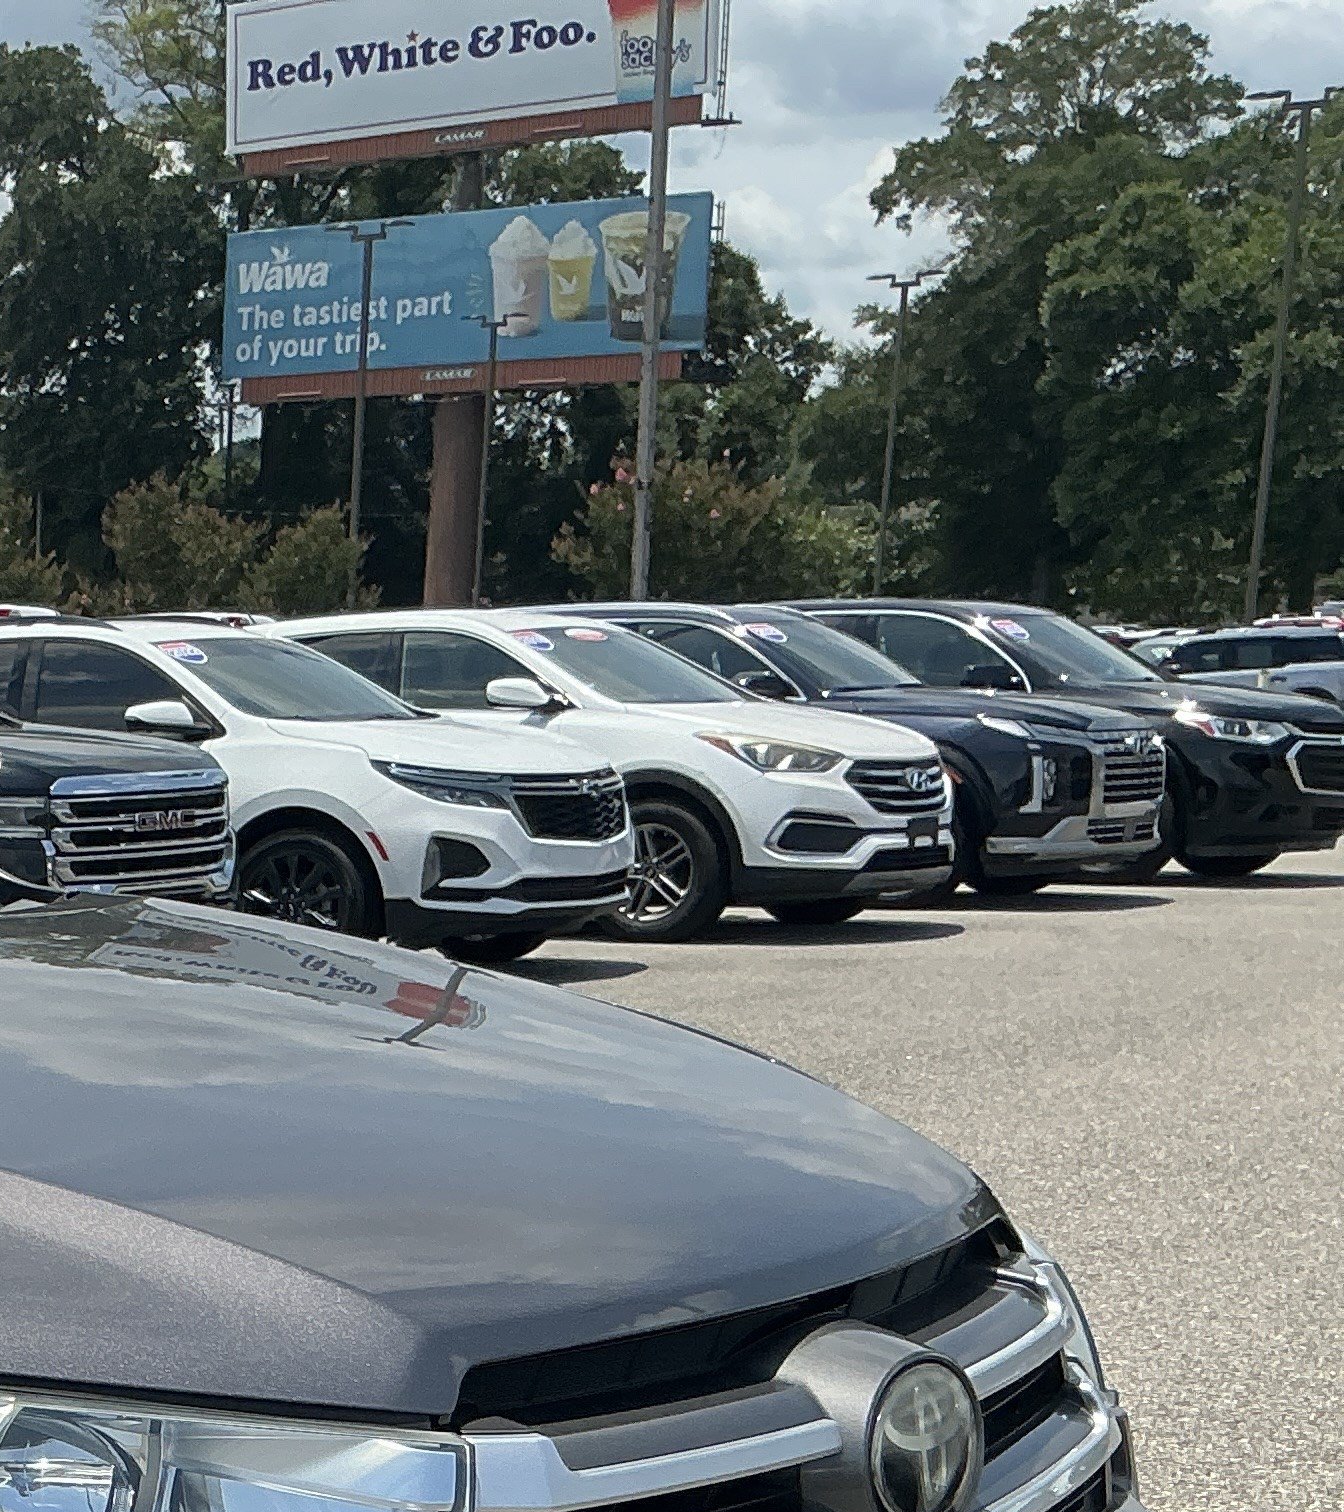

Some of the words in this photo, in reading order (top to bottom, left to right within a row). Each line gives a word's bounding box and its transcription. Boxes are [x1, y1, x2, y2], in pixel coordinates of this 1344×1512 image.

[246, 50, 333, 92] Red,
[335, 31, 460, 79] White
[468, 24, 505, 60] &
[509, 18, 597, 55] Foo.
[621, 29, 653, 54] foo
[238, 260, 330, 295] Wawa
[237, 304, 285, 331] The
[293, 296, 389, 325] tastiest
[395, 290, 453, 325] part
[235, 334, 263, 363] of
[268, 336, 328, 367] your
[334, 326, 387, 358] trip.
[134, 809, 196, 833] GMC
